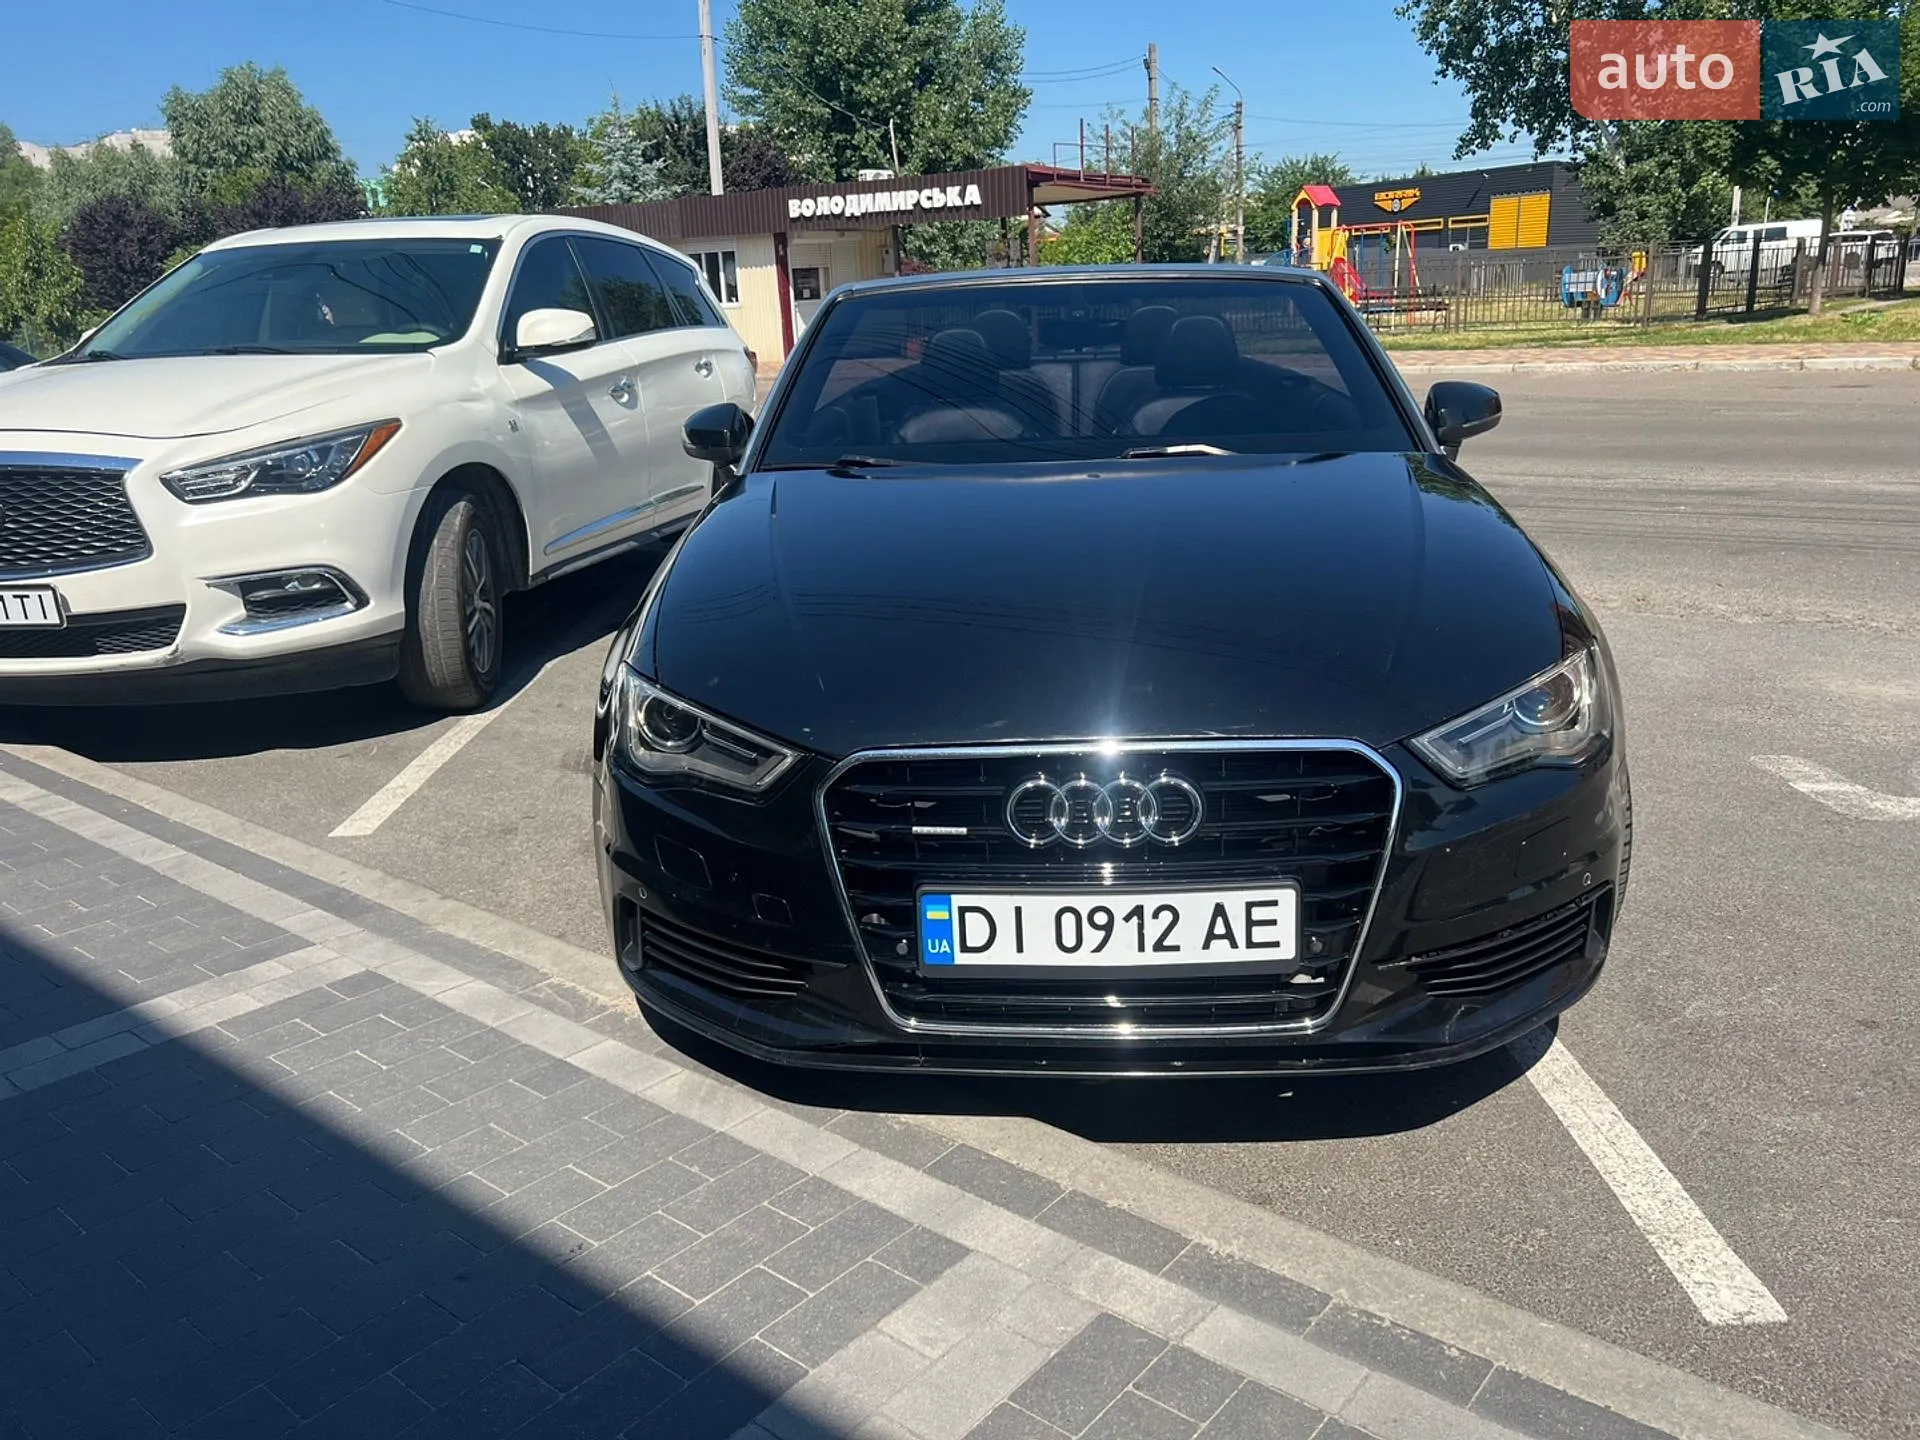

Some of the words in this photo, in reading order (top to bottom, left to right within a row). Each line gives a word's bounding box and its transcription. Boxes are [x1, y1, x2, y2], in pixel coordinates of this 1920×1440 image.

[788, 184, 982, 218] ВОЛОДИМИРСЬКА
[957, 905, 1025, 954] DI
[1054, 903, 1181, 954] 0912
[1201, 899, 1281, 951] AE
[927, 938, 951, 954] UA
